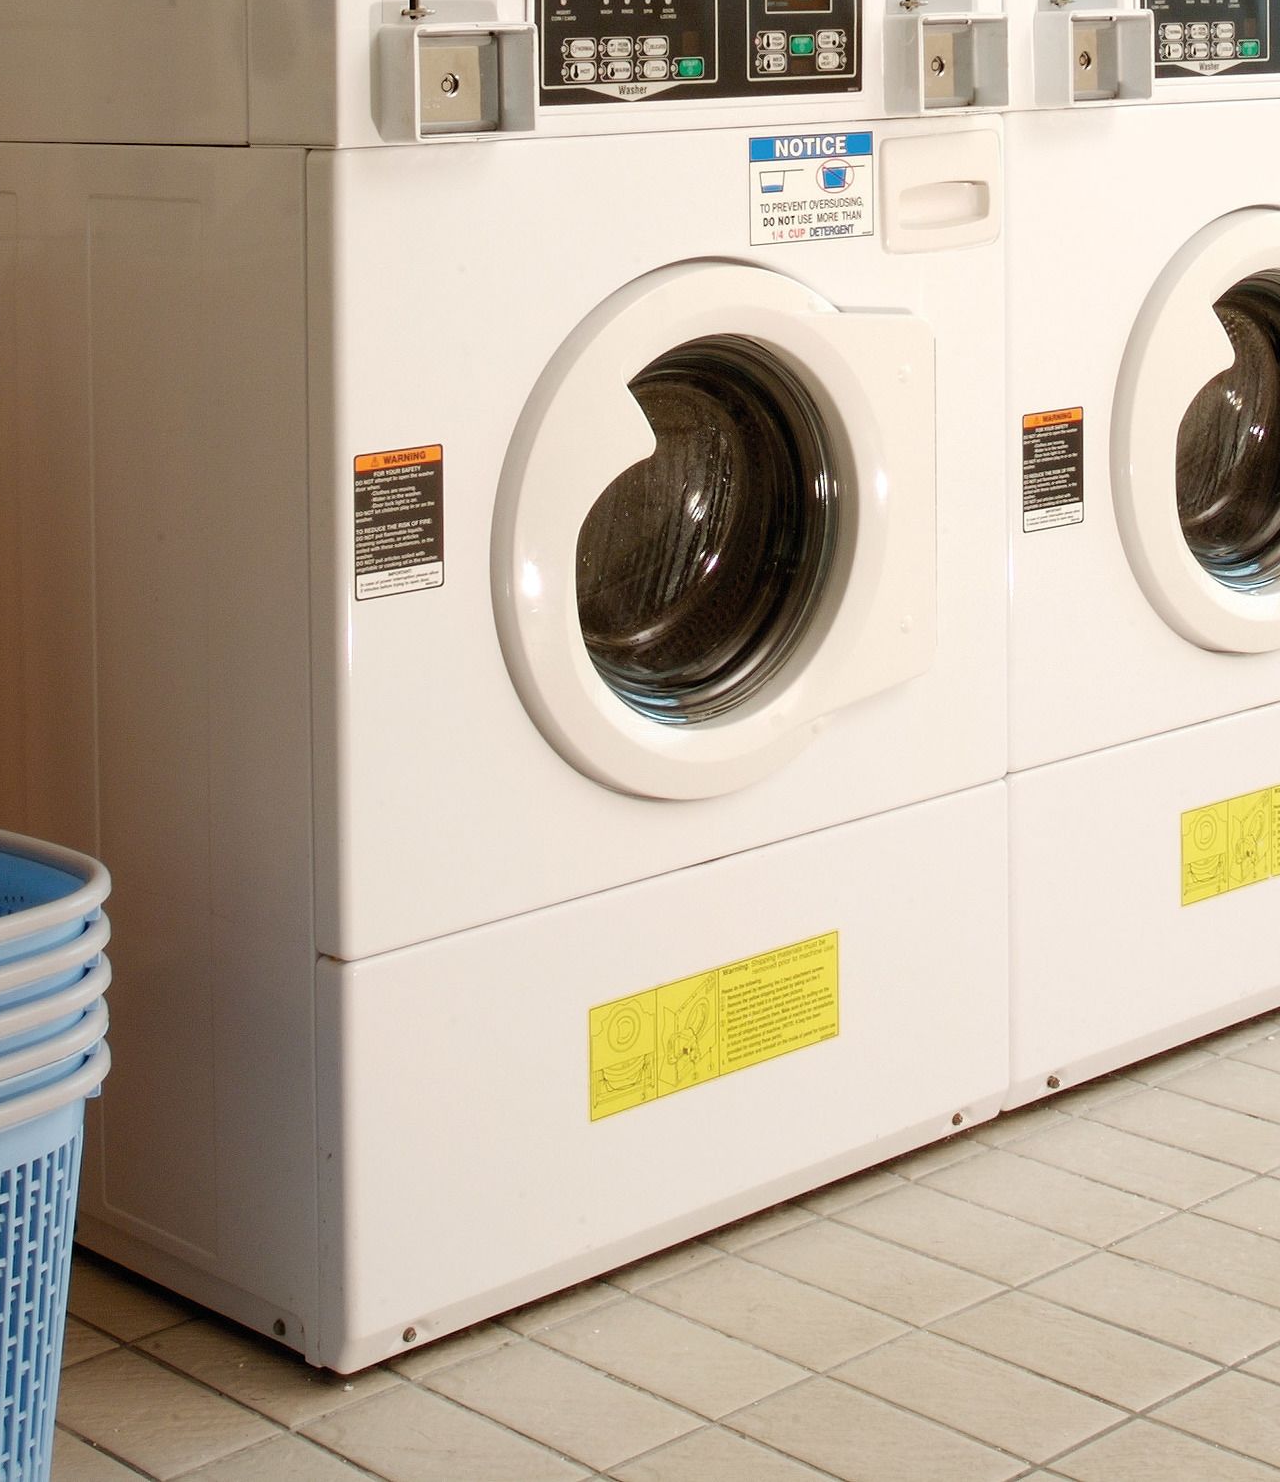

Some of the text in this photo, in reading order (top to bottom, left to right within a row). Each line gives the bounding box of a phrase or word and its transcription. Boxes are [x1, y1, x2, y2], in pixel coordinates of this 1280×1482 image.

[1199, 62, 1220, 71] Washer
[619, 85, 647, 95] Washer
[775, 136, 847, 157] NOTICE
[760, 197, 864, 214] TO PREVENT OVERSUDSING,
[763, 210, 862, 227] DO NOT USE MORE THAN
[772, 224, 854, 240] 1/4 CUP DETERGENT
[383, 451, 426, 464] WARNING
